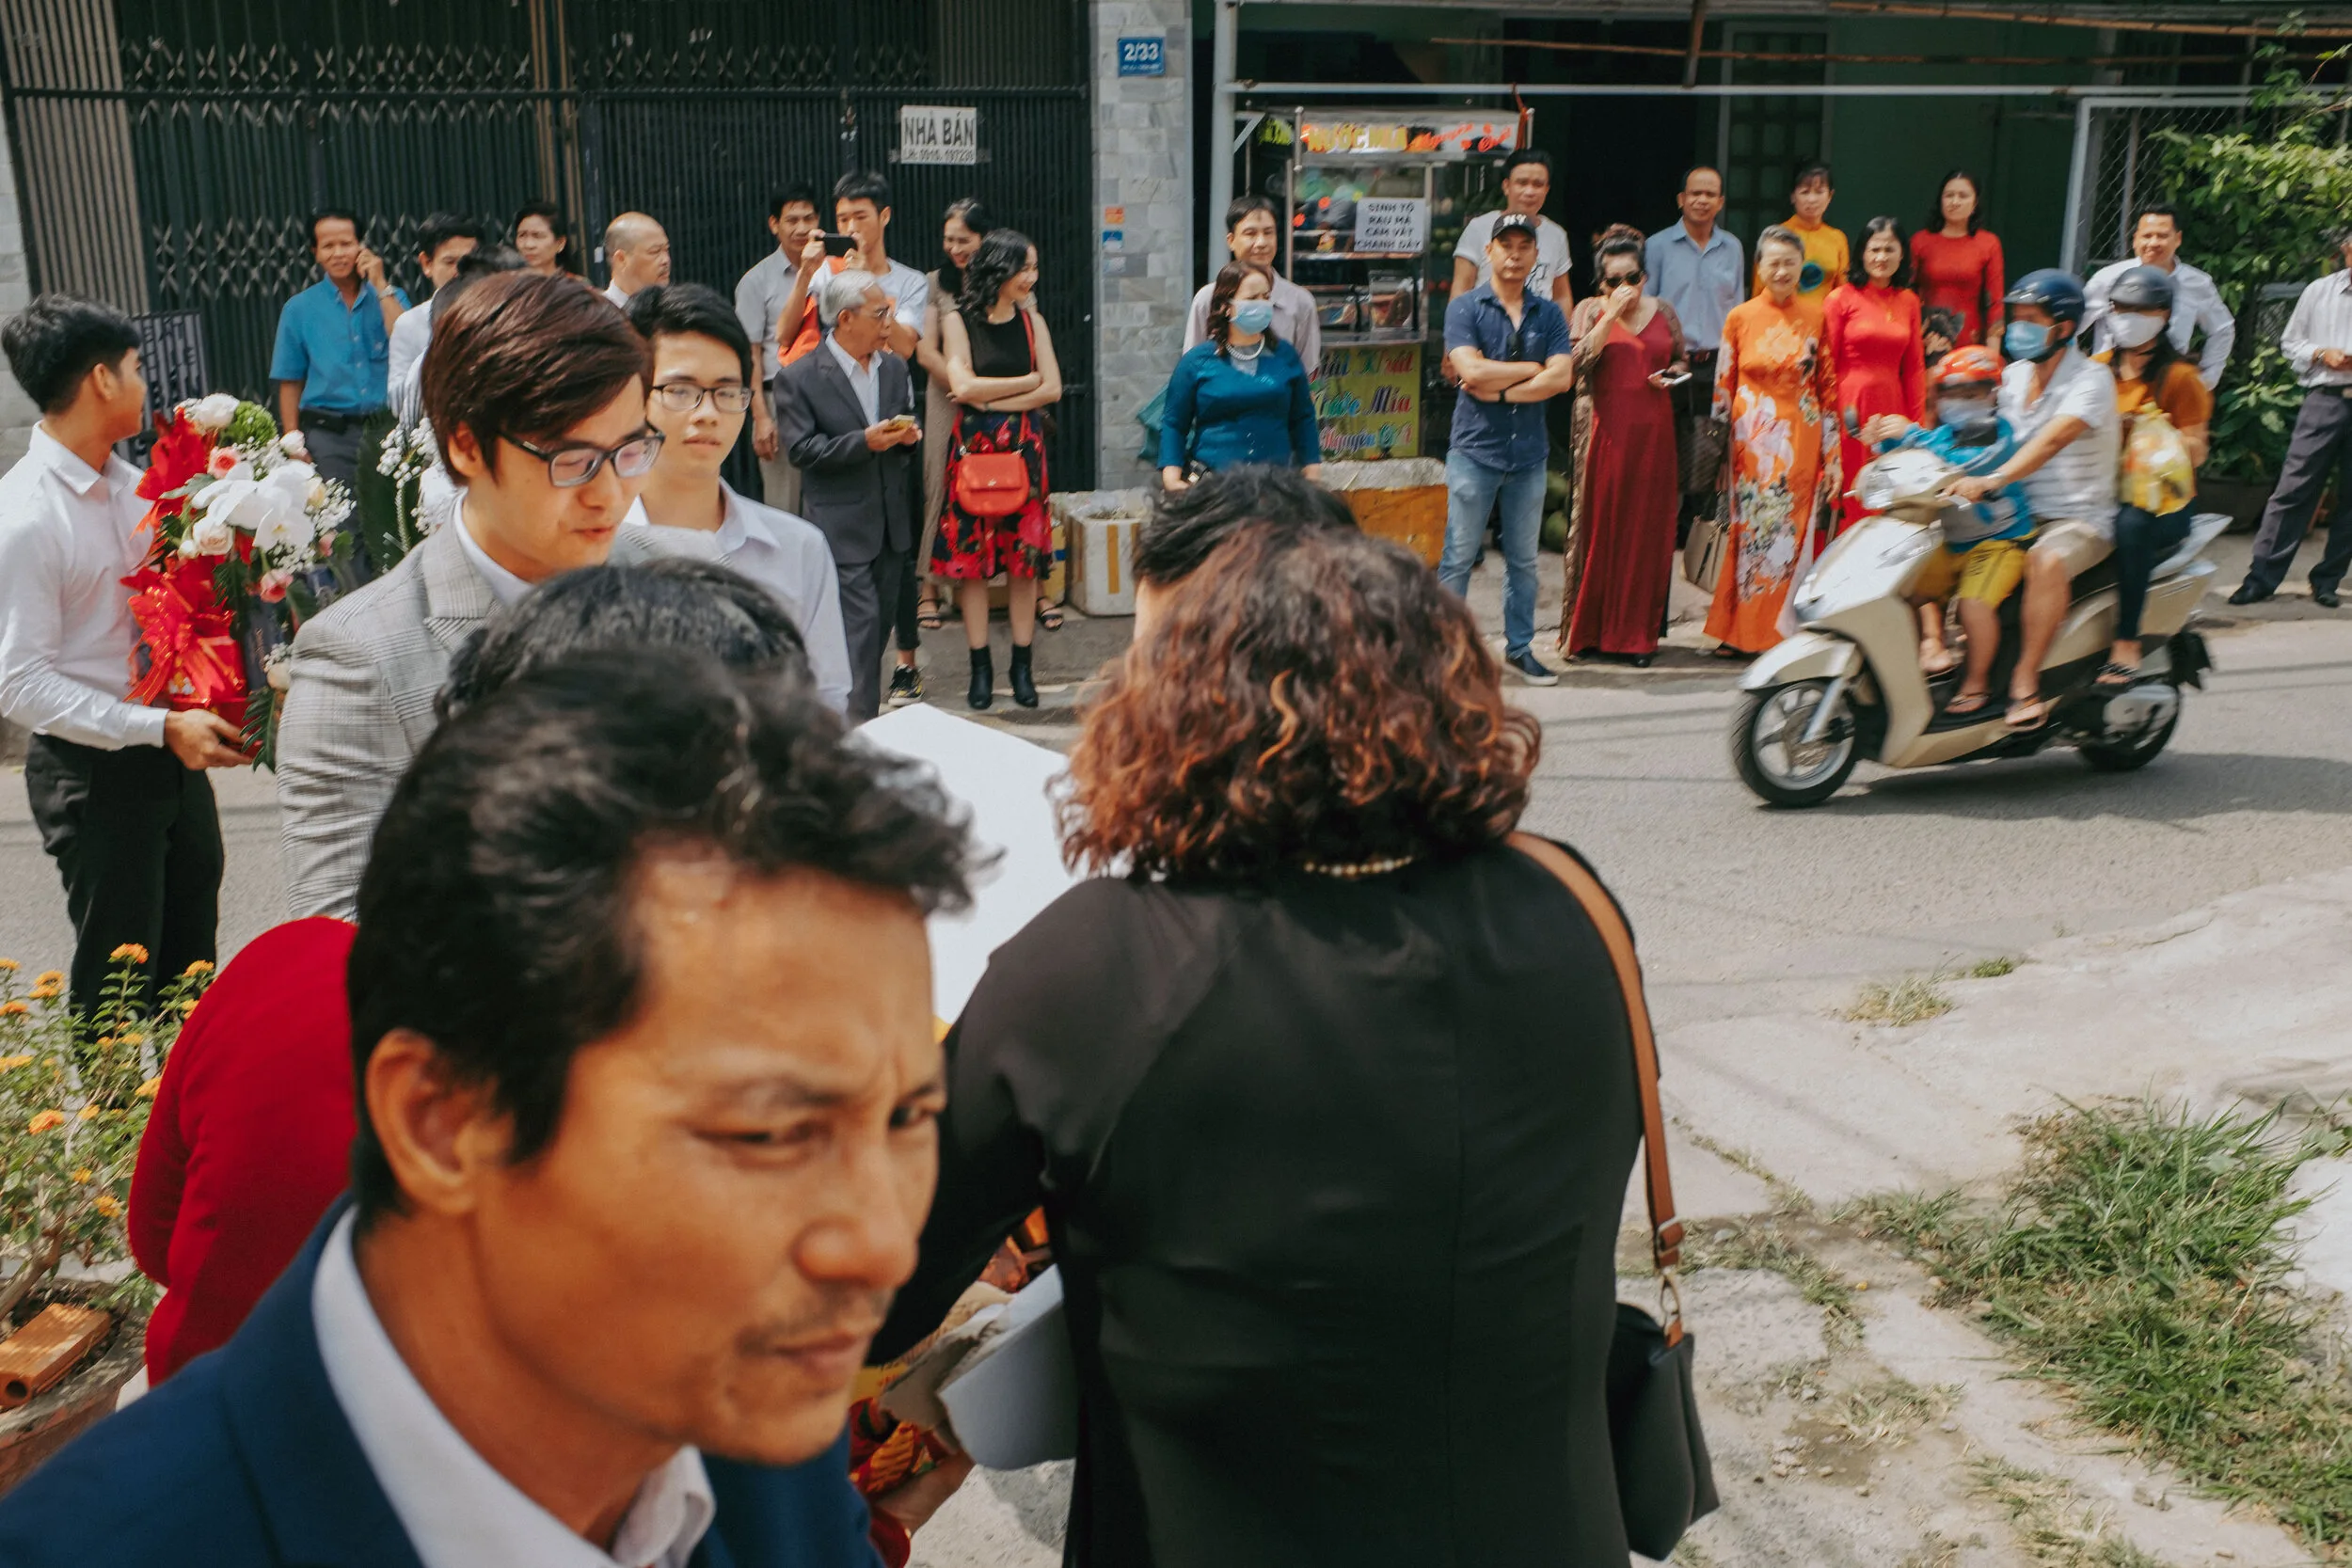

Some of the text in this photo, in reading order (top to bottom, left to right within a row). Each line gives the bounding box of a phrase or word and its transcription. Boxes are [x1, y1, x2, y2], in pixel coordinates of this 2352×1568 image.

[1124, 42, 1159, 62] 2/33
[904, 110, 974, 146] NHÀ BÁN
